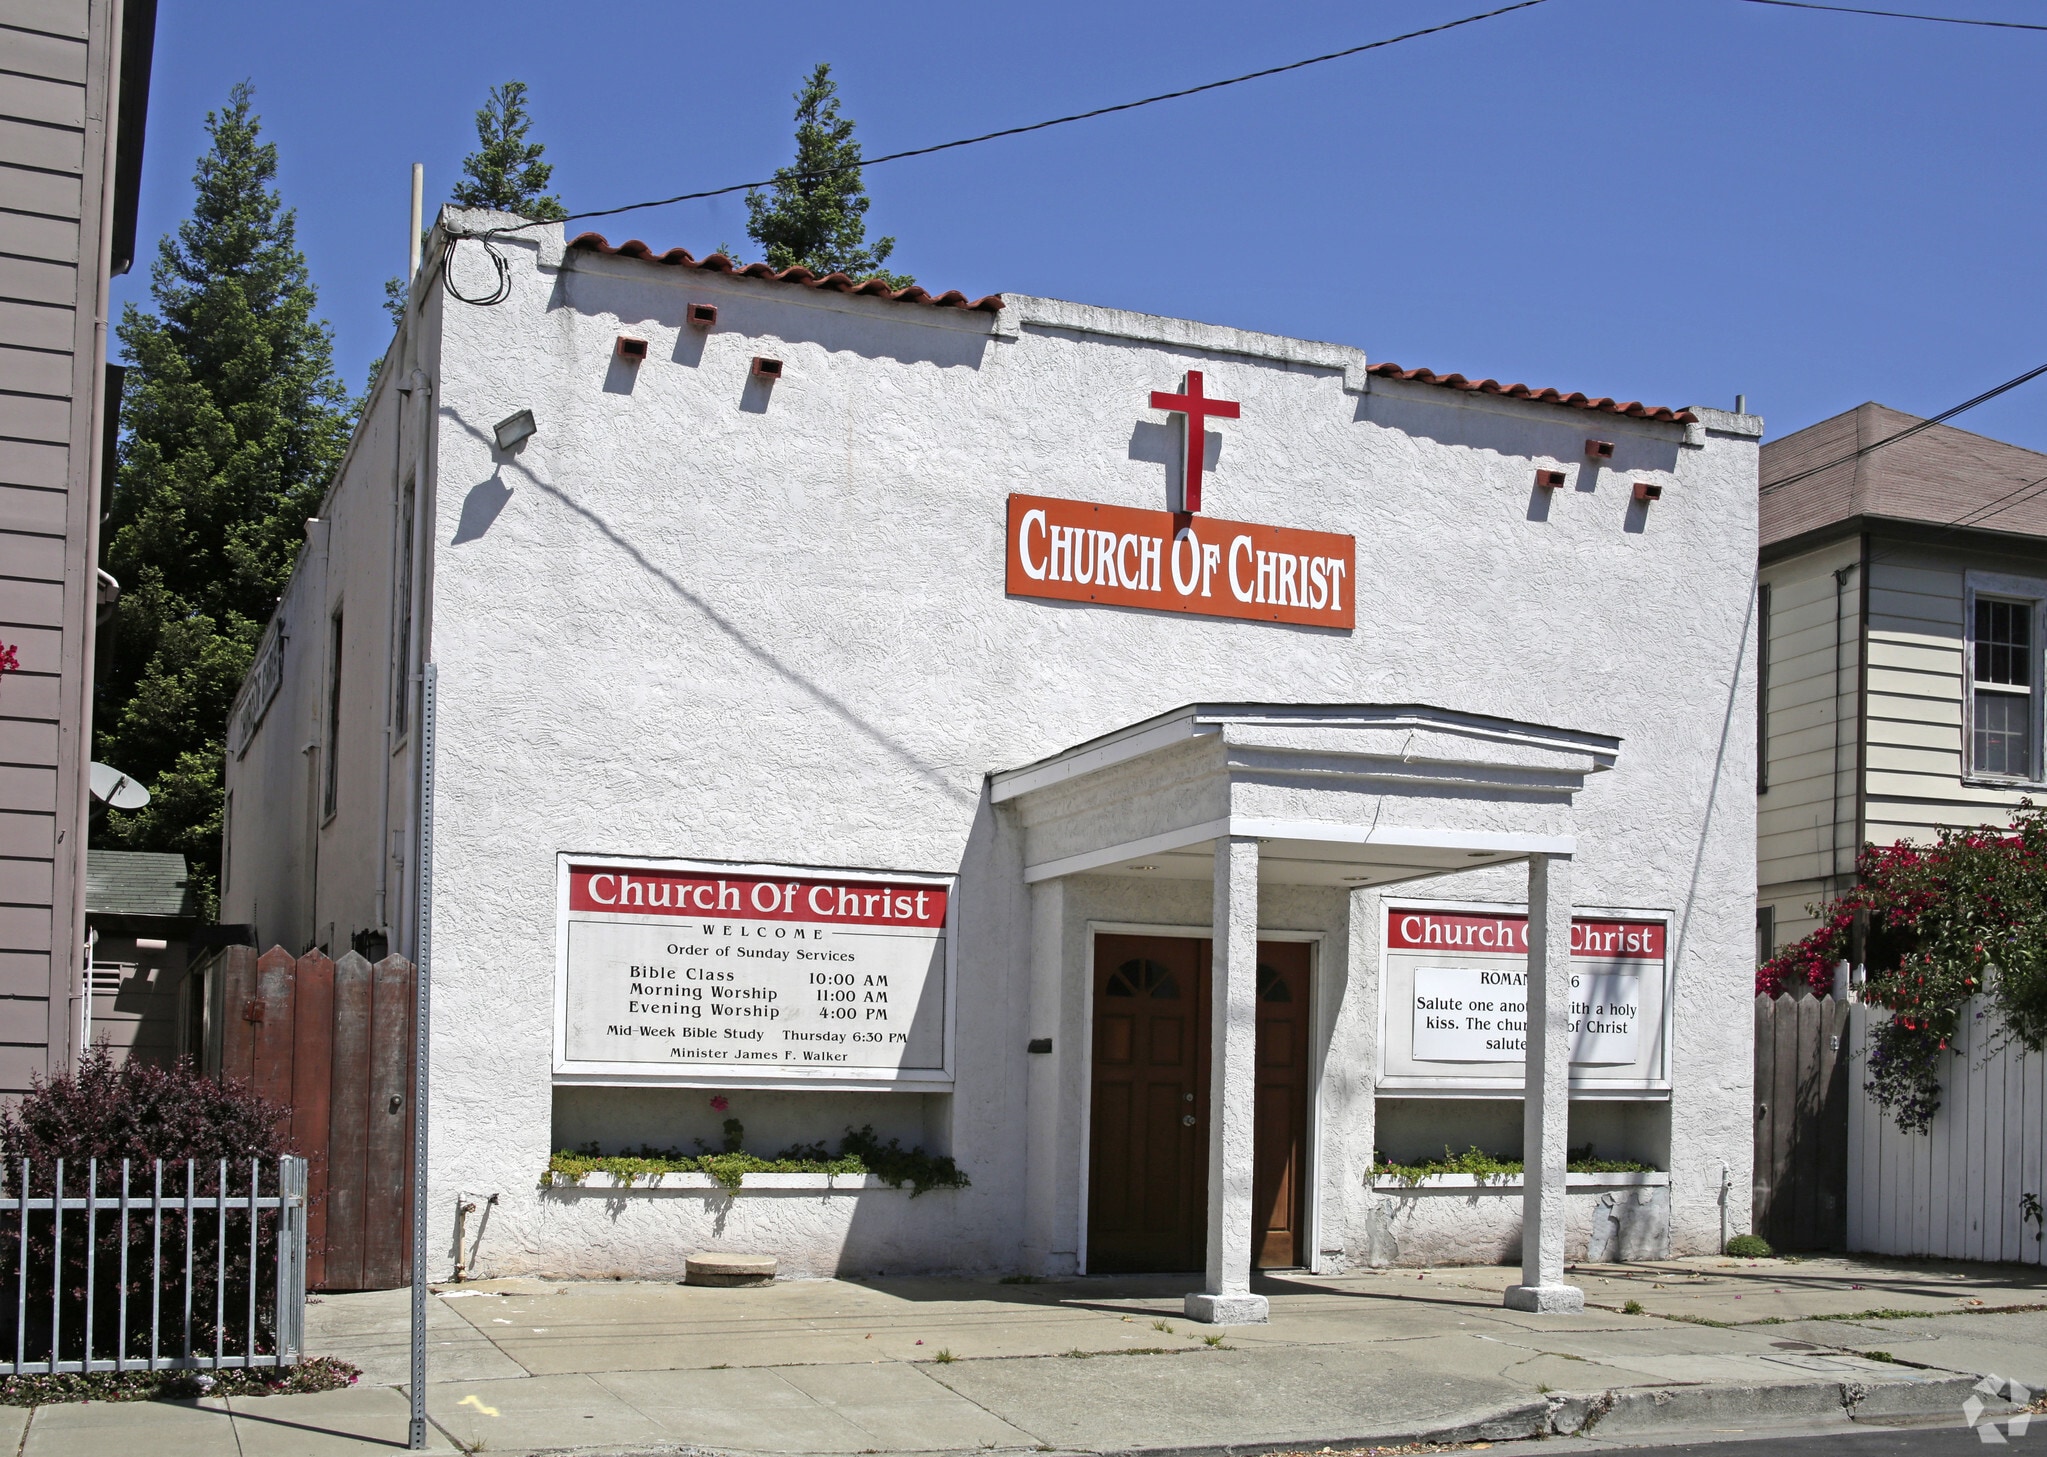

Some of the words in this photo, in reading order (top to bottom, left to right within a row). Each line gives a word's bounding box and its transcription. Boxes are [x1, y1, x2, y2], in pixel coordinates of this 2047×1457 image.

[1019, 509, 1162, 592] CHURCH
[1171, 527, 1220, 597] OF
[1228, 535, 1346, 611] CHRIST
[588, 873, 741, 911] Church
[751, 882, 800, 913] Of
[808, 886, 930, 920] Christ
[703, 925, 824, 940] WELCOME
[1400, 916, 1514, 947] Church
[1570, 925, 1653, 952] Christ
[667, 944, 711, 956] Order
[715, 946, 729, 957] of
[737, 946, 790, 961] Sunday
[796, 949, 855, 962] Services
[630, 966, 676, 980] Bible
[686, 968, 734, 981] Class
[809, 973, 855, 985] 10:00
[863, 974, 888, 986] AM
[630, 983, 702, 1000] Morning
[711, 986, 777, 1002] Worship
[816, 990, 856, 1003] 11:00
[863, 991, 888, 1004] AM
[629, 1001, 701, 1017] Evening
[711, 1003, 780, 1019] Worship
[819, 1007, 857, 1020] 4:00
[865, 1008, 887, 1020] PM
[1416, 997, 1462, 1010] Salute
[1469, 1002, 1494, 1011] one
[1569, 1002, 1589, 1015] ith
[1596, 1005, 1603, 1015] a
[1610, 1003, 1637, 1019] holy
[607, 1025, 675, 1038] Mid-Week
[683, 1027, 717, 1039] Bible
[724, 1029, 764, 1042] Study
[783, 1030, 846, 1044] Thursday
[852, 1031, 883, 1042] 6:30
[889, 1032, 907, 1043] PM
[1426, 1016, 1459, 1030] kiss.
[1466, 1017, 1491, 1030] The
[1568, 1020, 1582, 1033] of
[1587, 1020, 1628, 1034] Christ
[670, 1048, 727, 1059] Minister
[734, 1049, 778, 1060] James
[785, 1050, 796, 1060] F.
[803, 1051, 848, 1062] Walker
